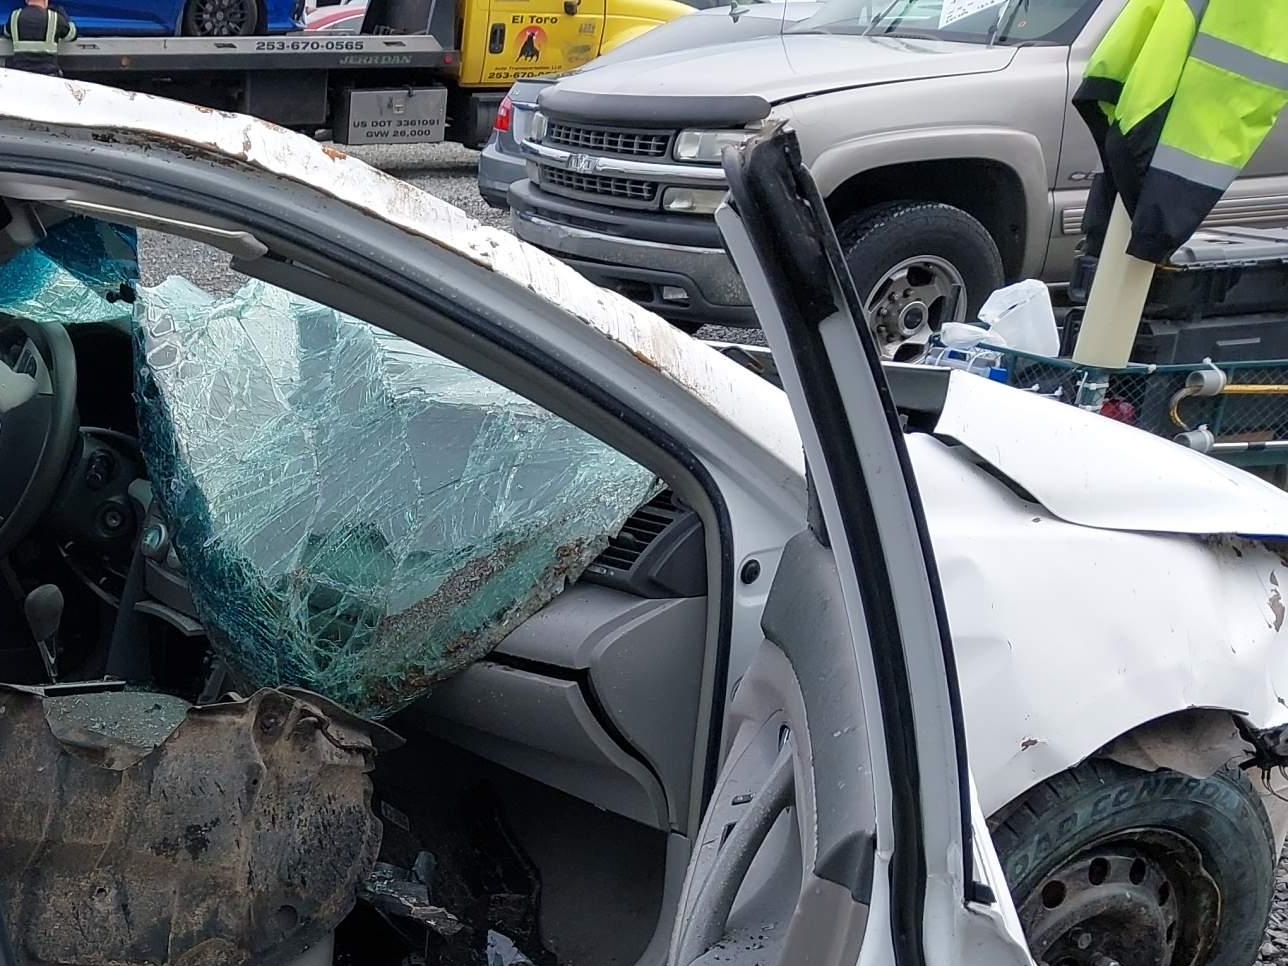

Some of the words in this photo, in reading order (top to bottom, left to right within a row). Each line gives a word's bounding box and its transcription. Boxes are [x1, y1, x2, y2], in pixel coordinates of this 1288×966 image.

[511, 15, 524, 24] El
[528, 15, 559, 24] Toro
[255, 41, 364, 50] 253-670-0565
[353, 120, 367, 128] US
[371, 120, 392, 128] DOT
[366, 130, 389, 138] GVW
